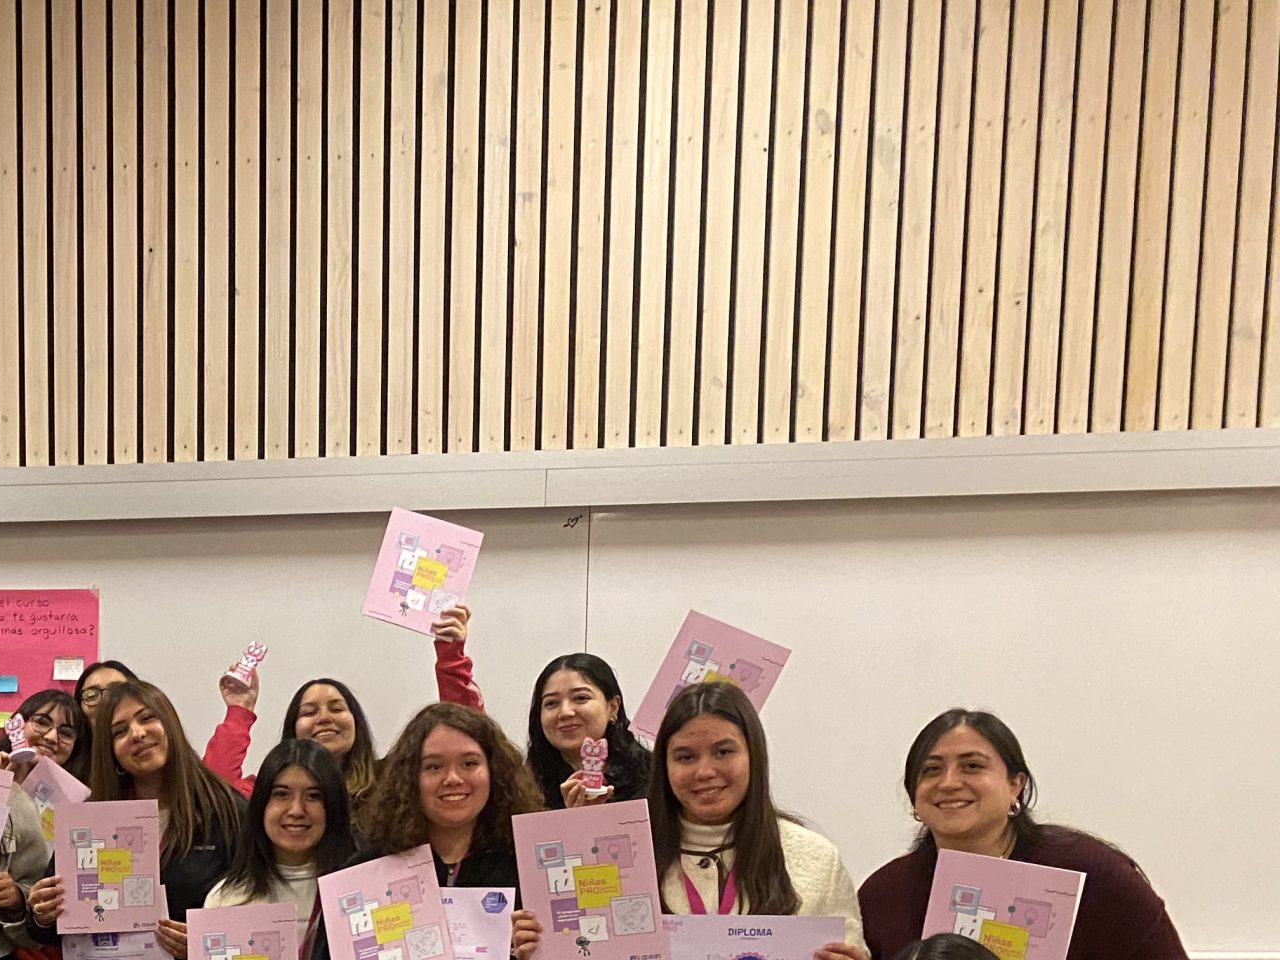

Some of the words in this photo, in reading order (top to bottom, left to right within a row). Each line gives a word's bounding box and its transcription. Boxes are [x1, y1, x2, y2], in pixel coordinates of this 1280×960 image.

[16, 599, 50, 607] curso
[30, 610, 79, 625] gustaría
[31, 624, 96, 640] orgullosa?
[579, 878, 607, 887] Niñas
[728, 928, 773, 936] DIPLOMA
[984, 934, 1012, 947] Niñas
